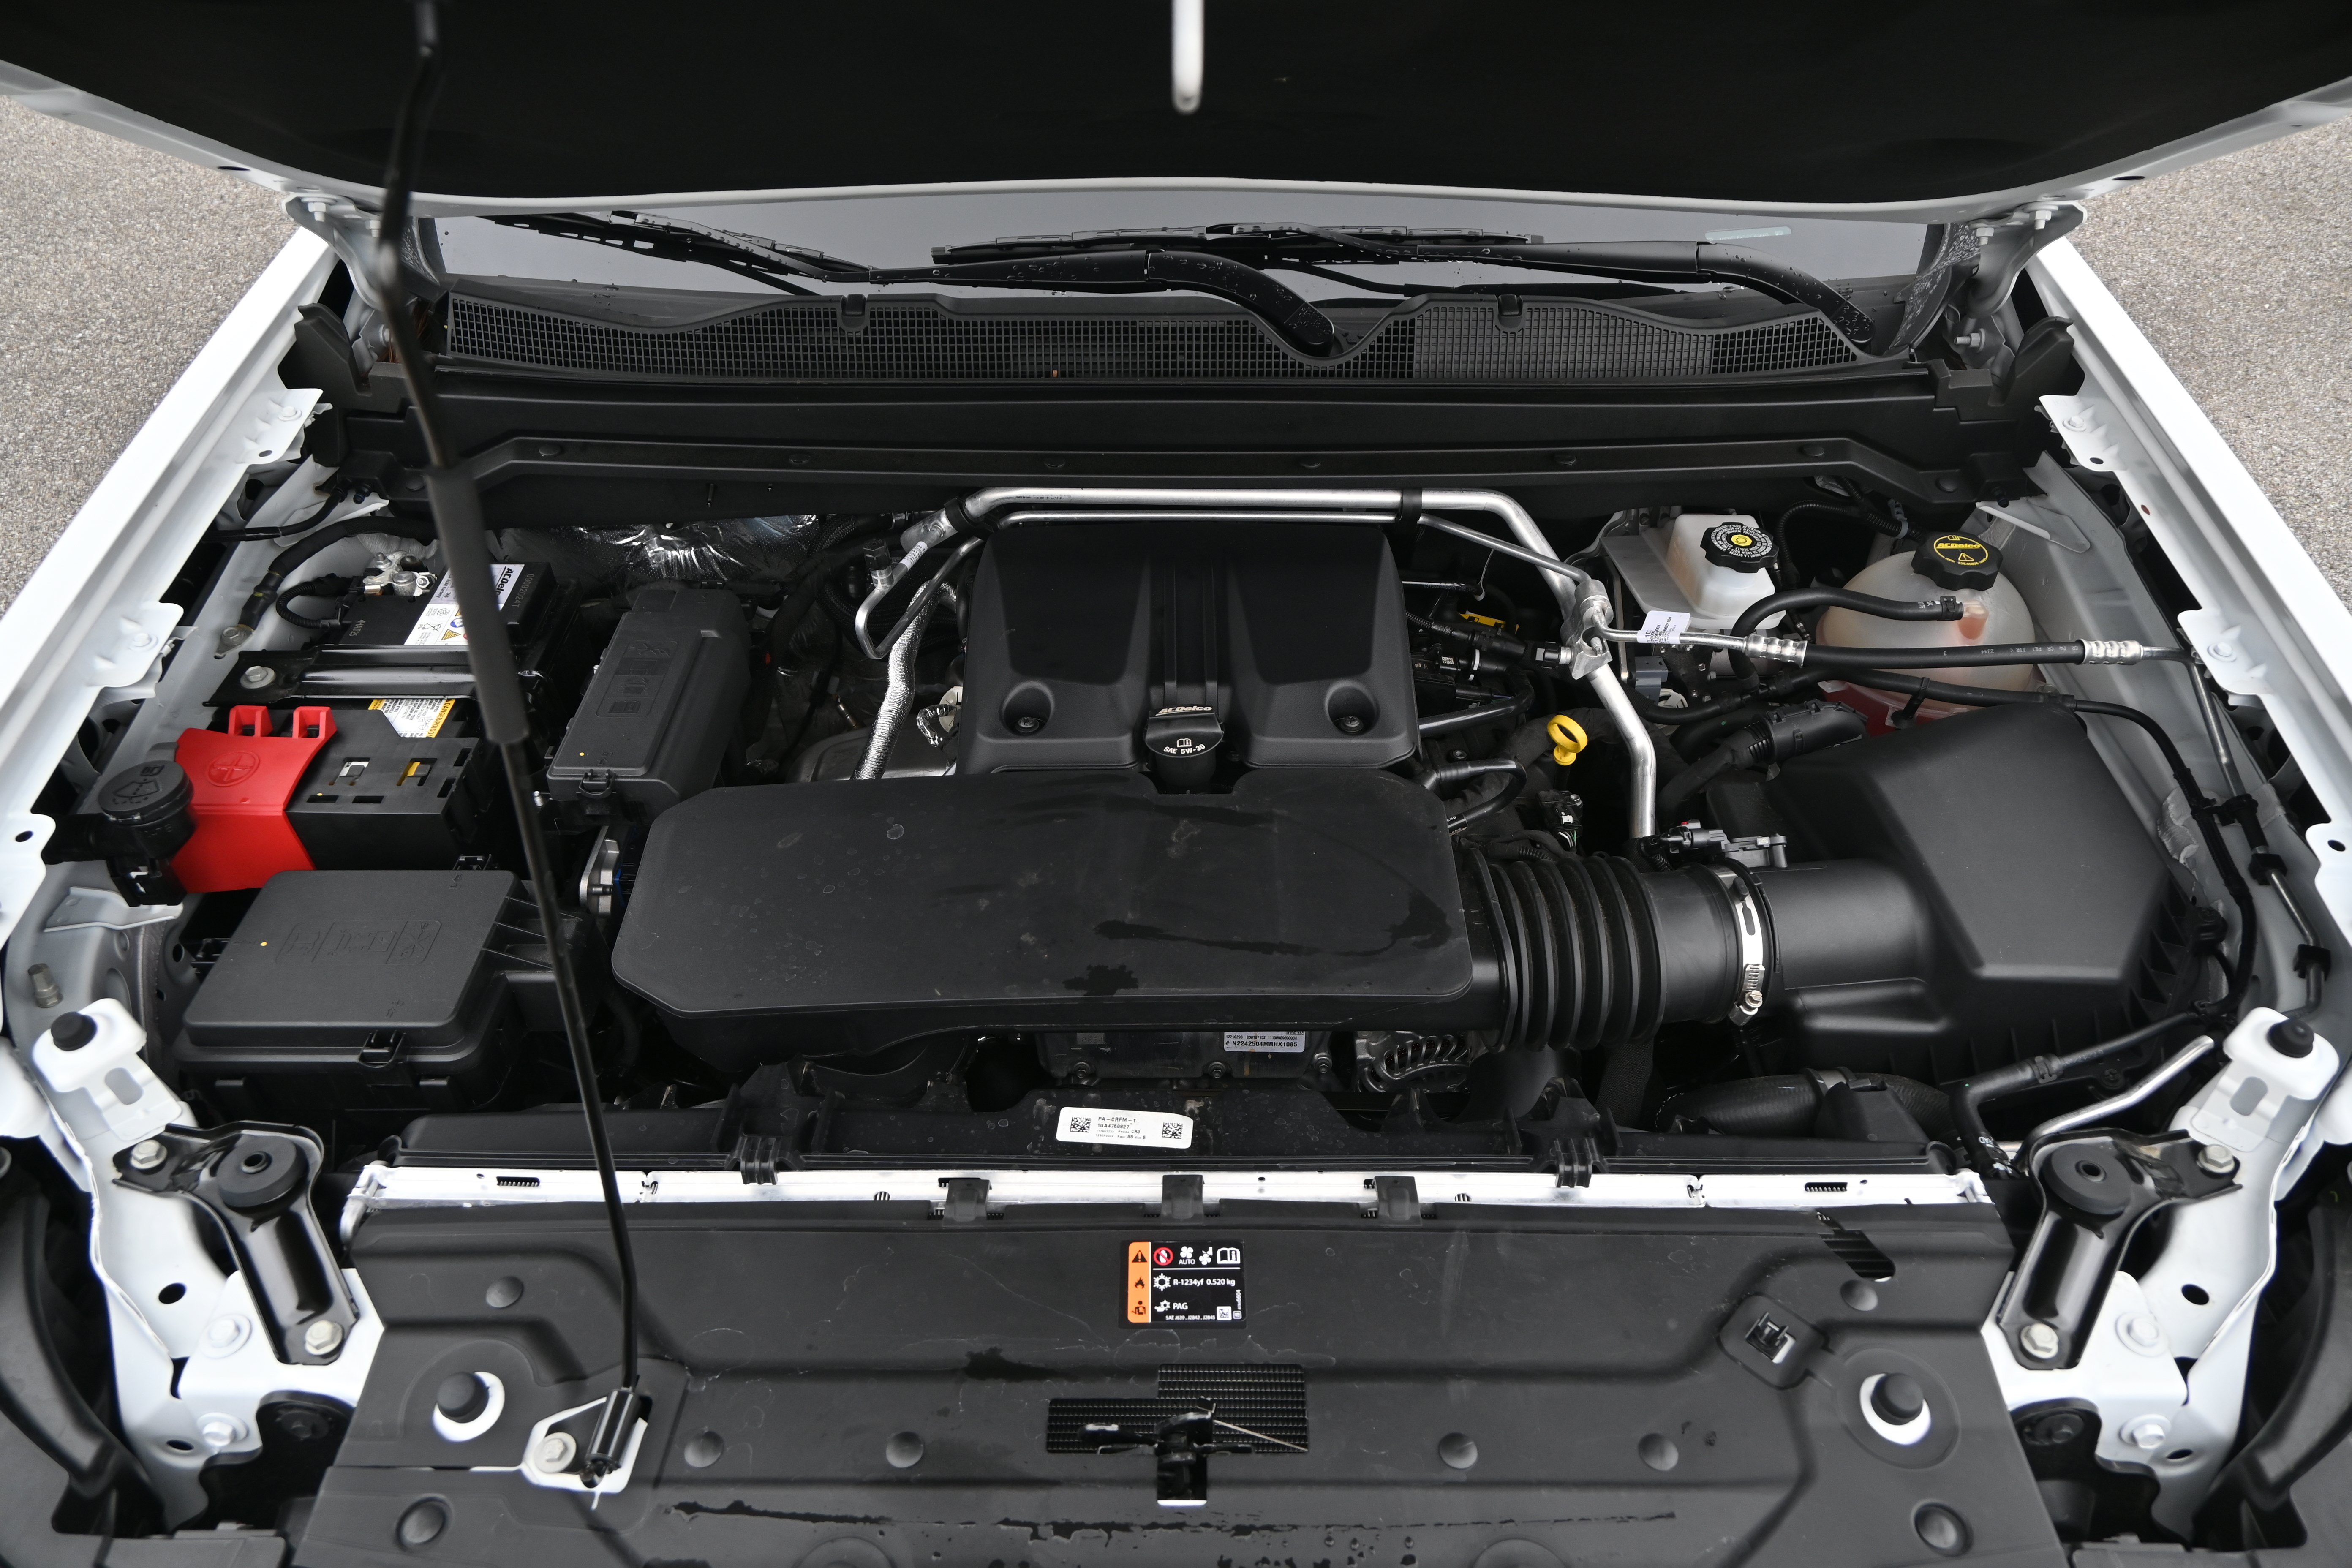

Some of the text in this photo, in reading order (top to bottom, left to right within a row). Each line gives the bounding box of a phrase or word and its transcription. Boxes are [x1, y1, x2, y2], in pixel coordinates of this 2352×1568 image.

[495, 566, 513, 596] ACDelc
[1157, 705, 1212, 714] ACDelco
[1163, 744, 1206, 754] SAE 5W-30
[1173, 1279, 1204, 1287] R-1234yf
[1226, 1278, 1235, 1286] kg
